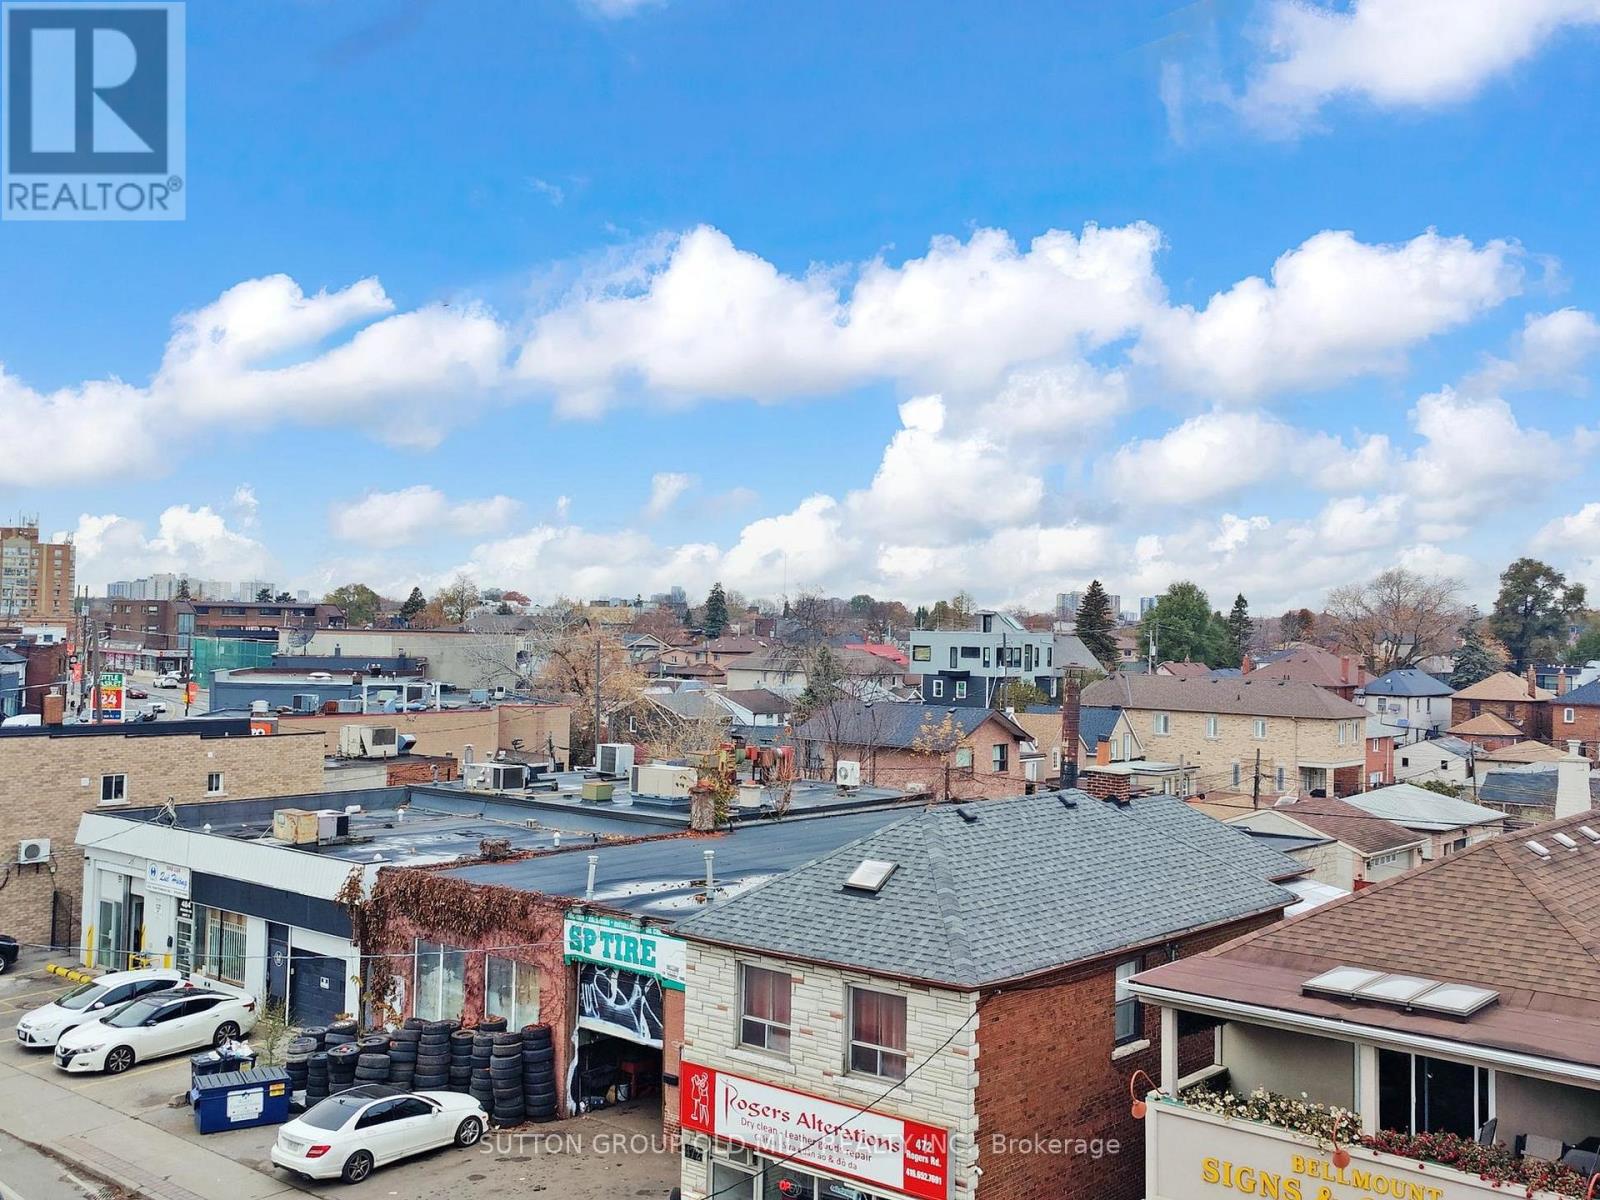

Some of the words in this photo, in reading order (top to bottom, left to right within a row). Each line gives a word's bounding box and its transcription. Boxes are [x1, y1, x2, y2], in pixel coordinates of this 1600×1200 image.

[569, 925, 597, 954] SP
[600, 931, 656, 968] TIRE
[720, 1079, 791, 1126] Rogers
[796, 1112, 900, 1153] Alterations
[740, 1117, 755, 1130] Dry
[756, 1122, 778, 1135] clean
[846, 1149, 873, 1162] repair
[905, 1149, 929, 1164] Rogers
[915, 1138, 934, 1153] 472
[1201, 1157, 1303, 1200] SIGNS
[1291, 1154, 1444, 1200] BELLMOUNT
